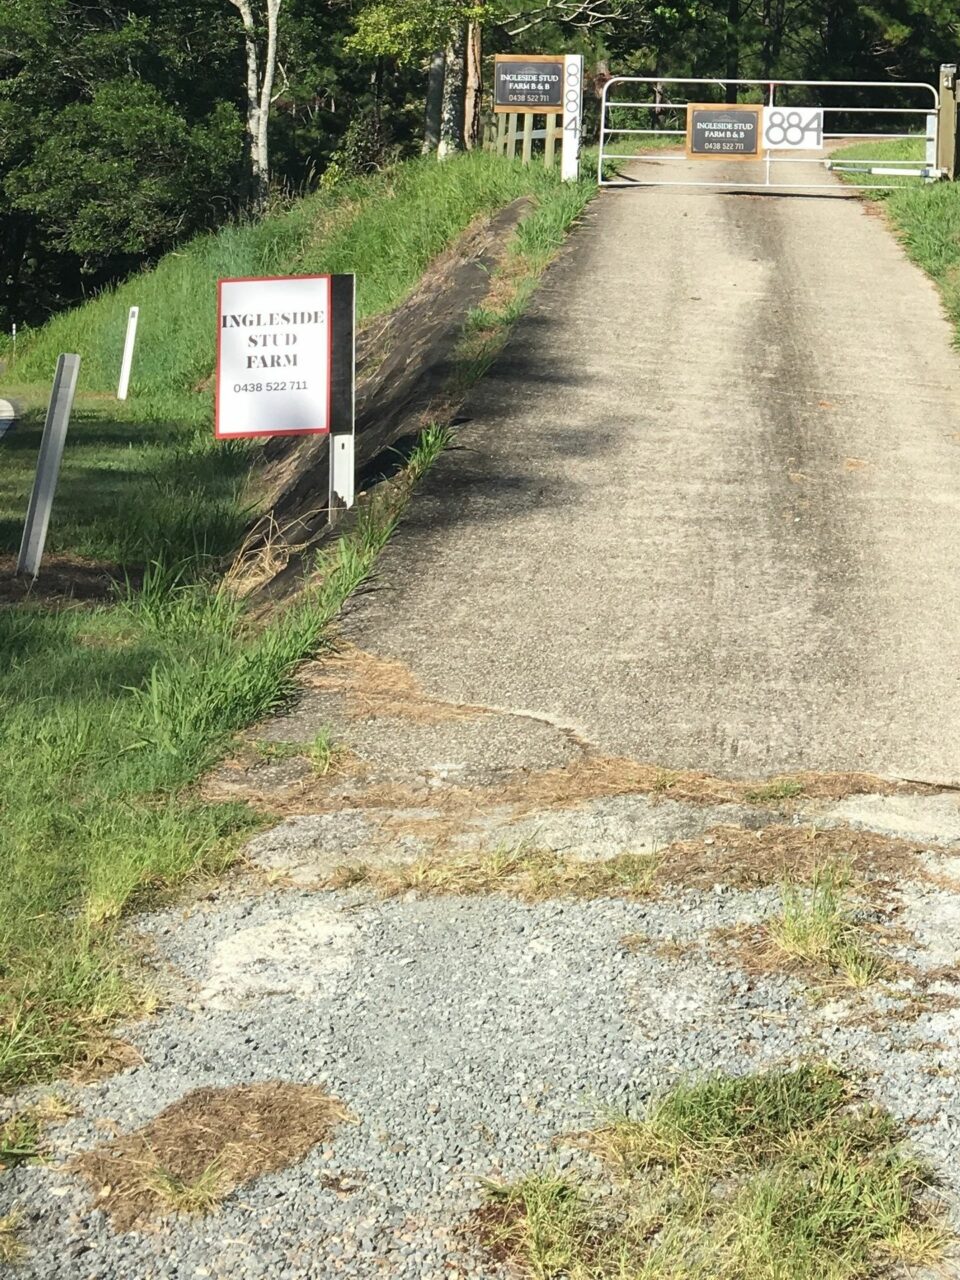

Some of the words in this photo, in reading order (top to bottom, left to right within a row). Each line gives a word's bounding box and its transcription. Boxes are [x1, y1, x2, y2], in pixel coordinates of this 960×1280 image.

[500, 74, 537, 82] INGLESIDE
[538, 74, 559, 82] STUD
[508, 94, 526, 102] 0438
[527, 95, 539, 103] 522
[540, 95, 550, 103] 711
[564, 63, 582, 139] 884
[697, 122, 734, 131] INGLESIDE
[734, 122, 754, 131] STUD
[765, 111, 821, 146] 884
[704, 131, 725, 139] FARM
[726, 131, 732, 139] B
[739, 131, 745, 139] B
[704, 142, 721, 150] 0438
[722, 142, 734, 150] 522
[735, 142, 744, 150] 711
[221, 310, 325, 328] INGLESIDE
[248, 333, 298, 348] STUD
[246, 354, 298, 370] FARM
[233, 383, 263, 393] 0438
[265, 381, 287, 392] 522
[289, 380, 308, 390] 711
